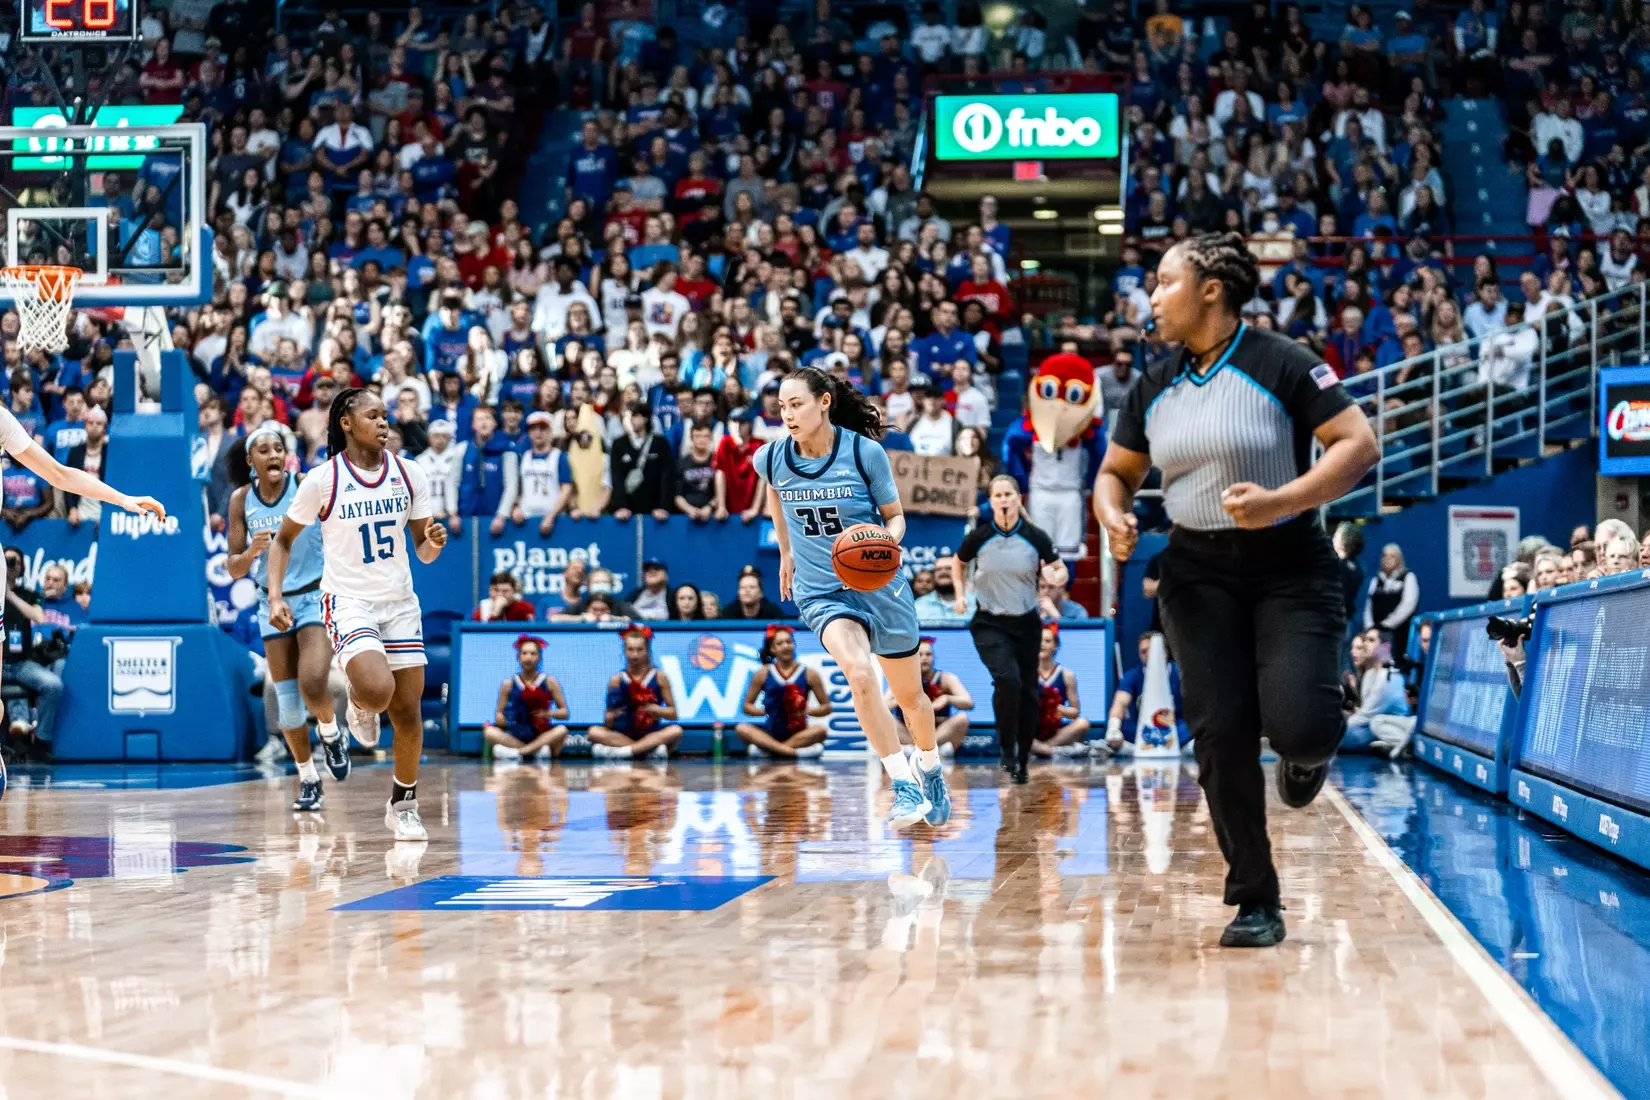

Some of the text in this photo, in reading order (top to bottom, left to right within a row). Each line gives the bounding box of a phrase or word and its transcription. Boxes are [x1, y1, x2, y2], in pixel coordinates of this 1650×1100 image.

[1005, 107, 1101, 147] fnbo
[780, 486, 853, 501] COLUMBIA
[338, 496, 409, 519] JAYHAWKS
[247, 515, 283, 530] COLUM
[794, 505, 845, 538] 35
[358, 520, 397, 564] 15
[851, 530, 895, 543] Wilson
[493, 541, 600, 575] planet
[861, 550, 892, 560] NCAA
[116, 658, 167, 667] SHELTER
[822, 659, 868, 752] NOIS
